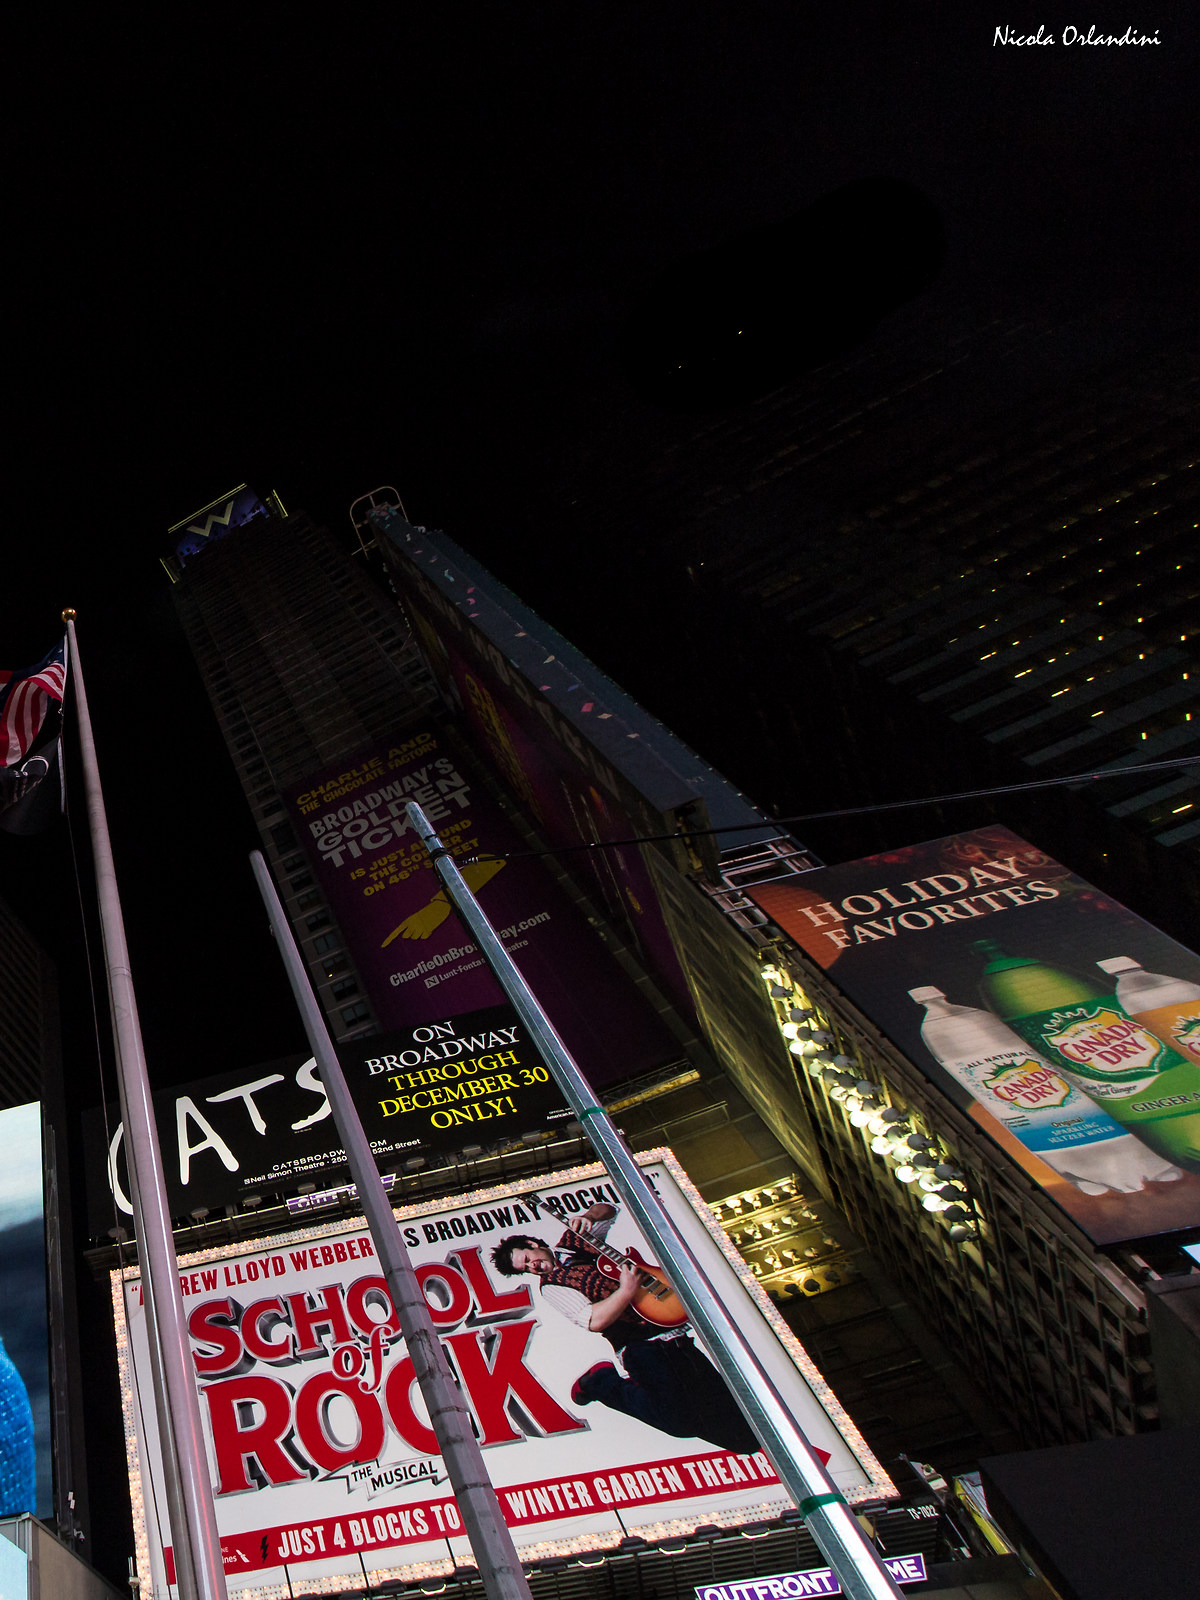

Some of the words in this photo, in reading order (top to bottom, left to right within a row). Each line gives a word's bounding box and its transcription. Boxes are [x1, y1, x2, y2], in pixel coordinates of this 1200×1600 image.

[296, 756, 384, 806] CHARLIE
[388, 732, 433, 760] AND
[299, 800, 321, 815] THE
[322, 767, 387, 803] CHOCOLATE
[386, 740, 438, 770] FACTORY
[308, 758, 455, 838] BROADWAY'S
[316, 771, 468, 852] GOLDEN
[322, 786, 472, 868] TICKET
[349, 867, 367, 881] IS
[369, 851, 407, 872] JUST
[369, 862, 399, 881] THE
[362, 880, 386, 897] ON
[797, 856, 1031, 929] HOLIDAY
[822, 879, 1060, 950] FAVORITES
[364, 1026, 520, 1076] BROADWAY
[412, 1021, 456, 1045] ON
[1059, 1019, 1145, 1063] CANADA
[1095, 1036, 1147, 1066] DRY
[388, 1050, 521, 1092] THROUGH
[966, 1060, 984, 1069] ALL
[984, 1051, 1032, 1064] NATURAL
[379, 1072, 519, 1118] DECEMBER
[523, 1066, 550, 1087] 30
[992, 1067, 1060, 1102] CANADA
[1021, 1080, 1060, 1104] DRY
[1131, 1094, 1192, 1113] GINGER
[430, 1096, 519, 1129] ONLY!
[266, 1168, 292, 1180] Simon
[293, 1160, 325, 1173] Theatre
[394, 1138, 421, 1150] Street
[223, 1255, 286, 1287] LLOYD
[288, 1237, 375, 1272] WEBBER
[421, 1201, 543, 1243] BROADWAY
[187, 1245, 532, 1377] SCHOOL
[332, 1324, 390, 1394] of
[199, 1319, 590, 1498] ROCK
[350, 1465, 373, 1482] THE
[371, 1460, 438, 1492] MUSICAL
[277, 1525, 325, 1558] JUST
[332, 1522, 347, 1549] 4
[348, 1508, 430, 1547] BLOCKS
[429, 1502, 461, 1531] TO
[504, 1480, 595, 1520] WINTER
[593, 1464, 686, 1504] GARDEN
[684, 1450, 777, 1490] THEATR
[906, 1504, 939, 1520] TS-7022
